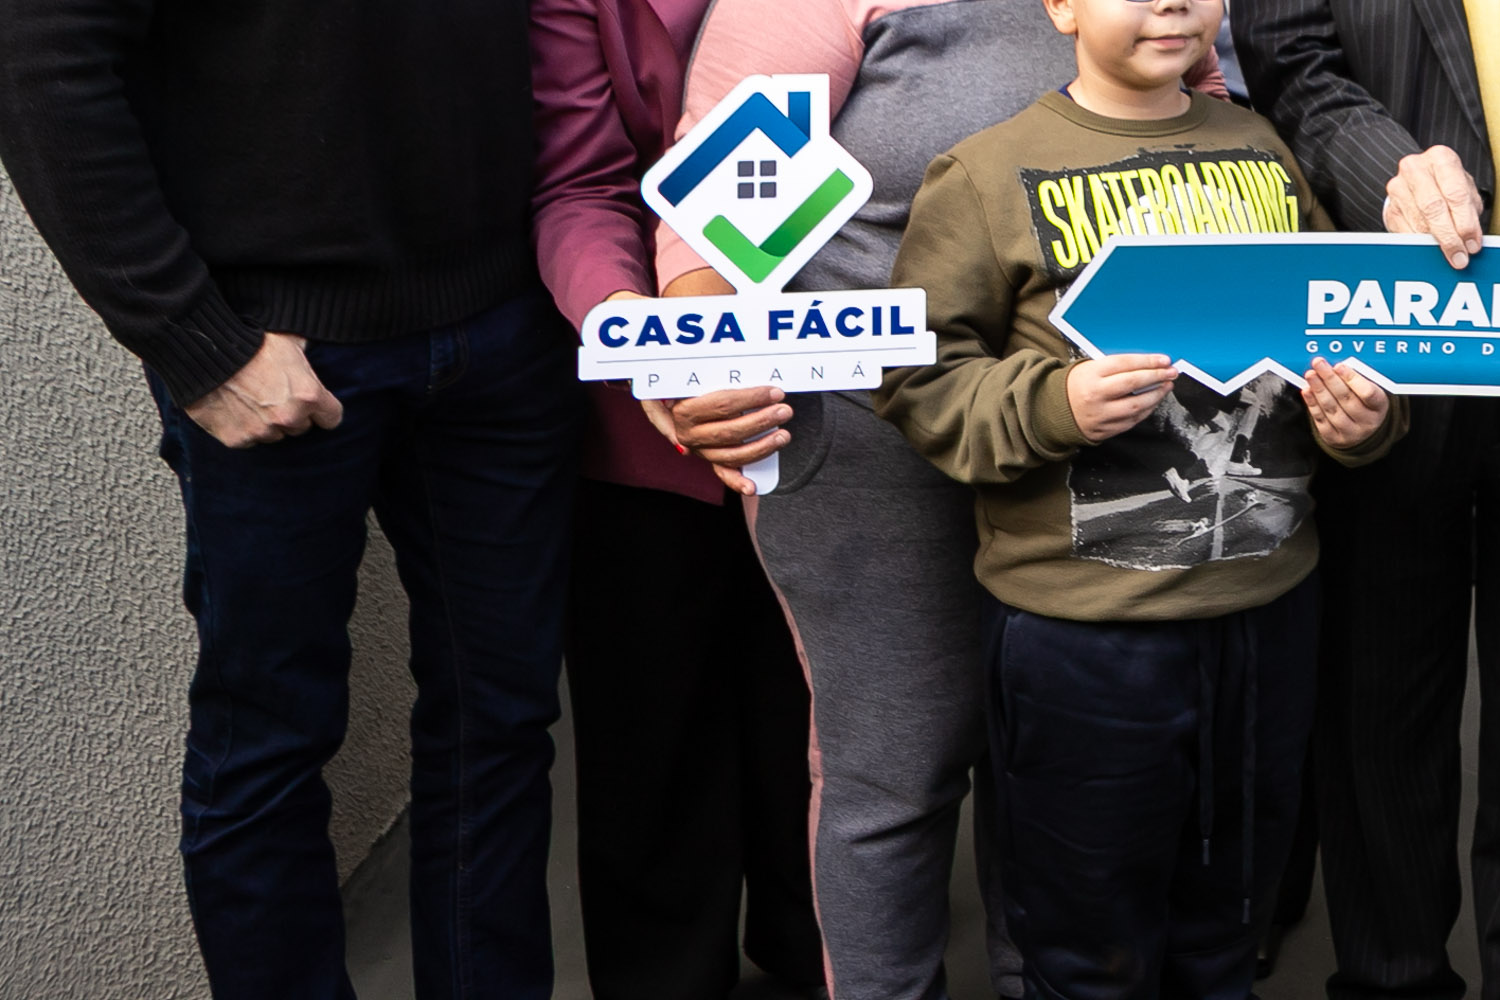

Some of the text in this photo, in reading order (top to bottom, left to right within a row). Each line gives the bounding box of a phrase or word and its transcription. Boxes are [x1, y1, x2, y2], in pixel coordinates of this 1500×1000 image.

[598, 300, 915, 348] CASA FÁCIL
[1305, 340, 1456, 355] GOVERNO
[647, 361, 865, 388] PARANÁ
